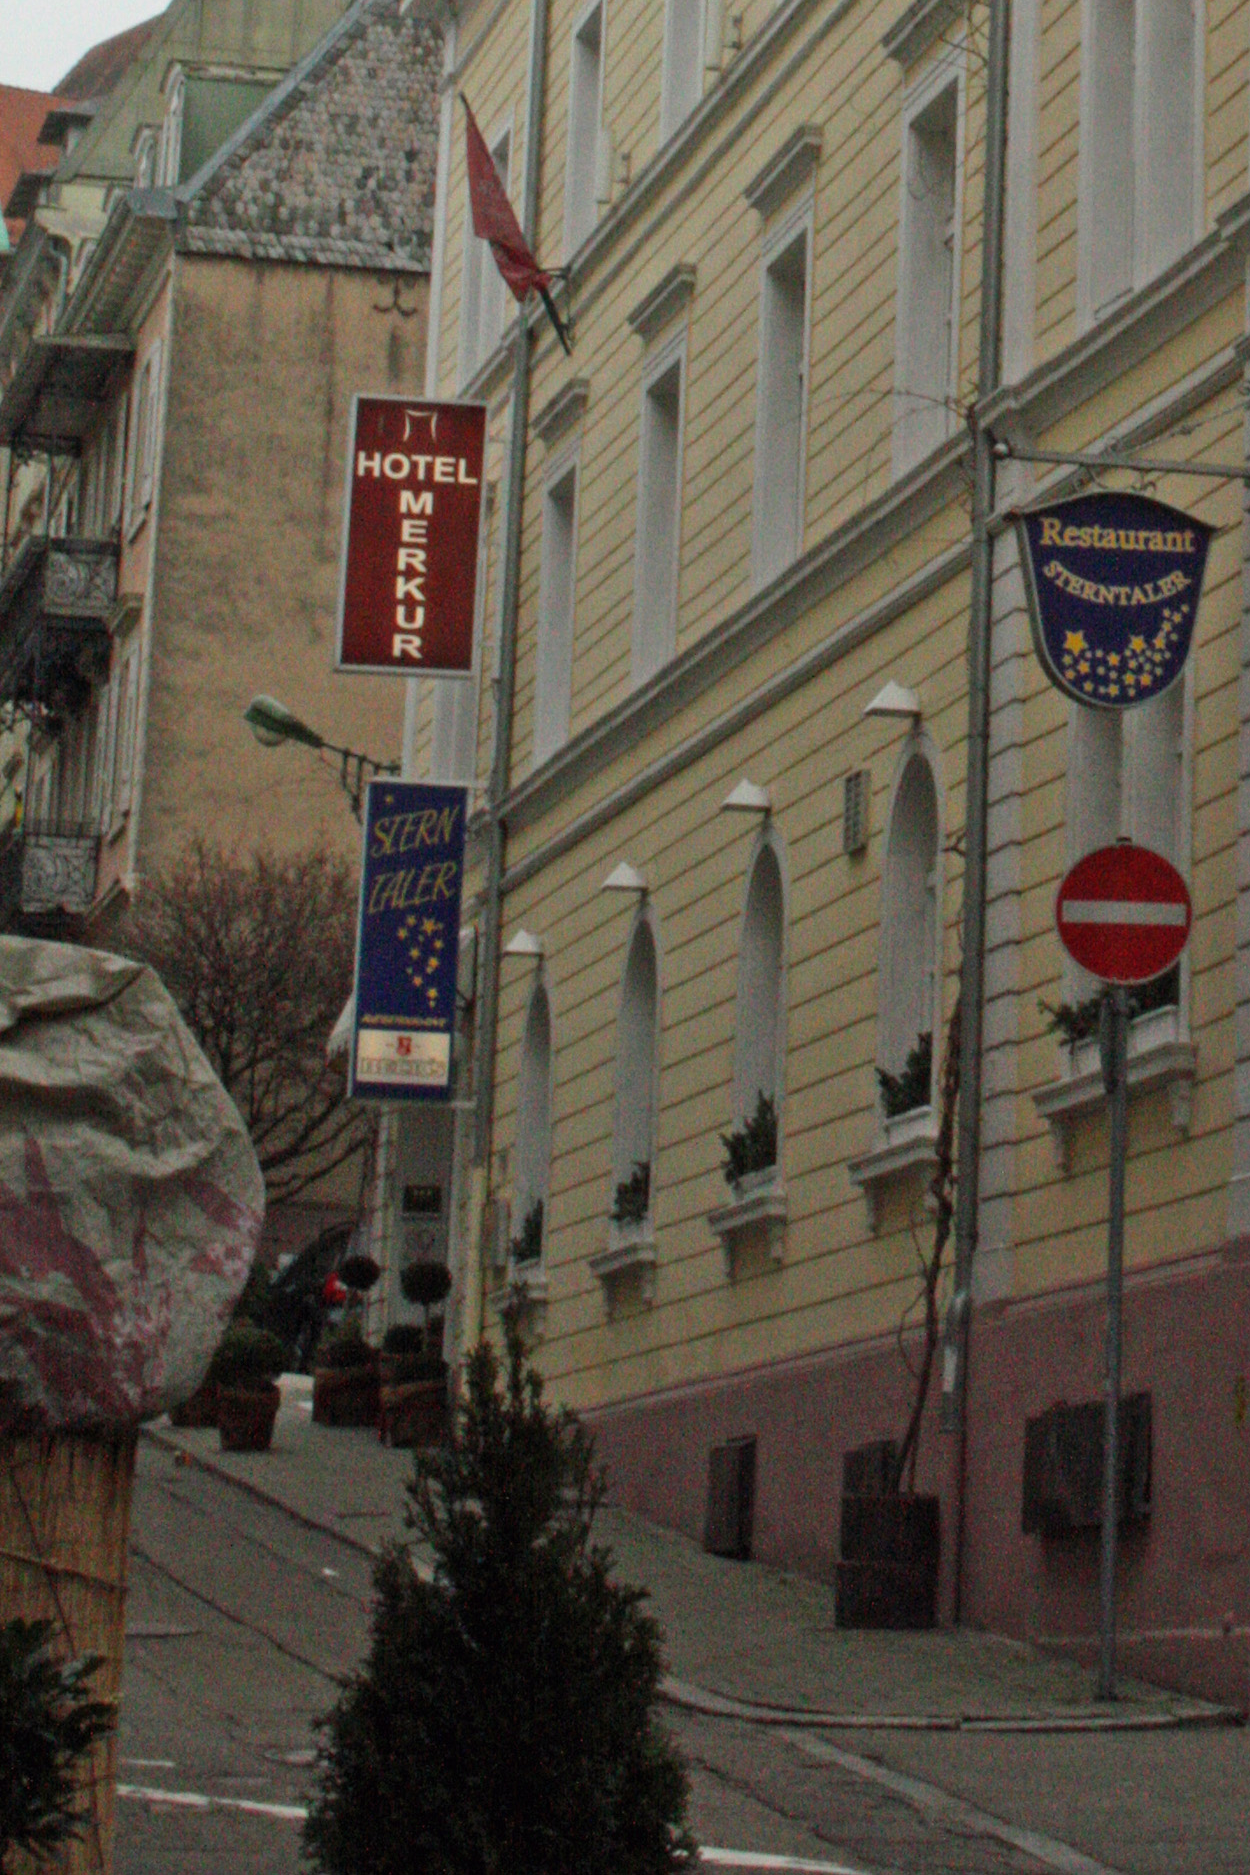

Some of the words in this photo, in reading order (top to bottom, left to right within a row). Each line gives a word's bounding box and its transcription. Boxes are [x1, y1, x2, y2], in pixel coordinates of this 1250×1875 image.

[357, 451, 478, 485] HOTEL
[1040, 517, 1195, 553] Restaurant
[392, 490, 434, 659] MERKUR
[1043, 560, 1192, 606] STERNTALER
[372, 806, 460, 858] STERN
